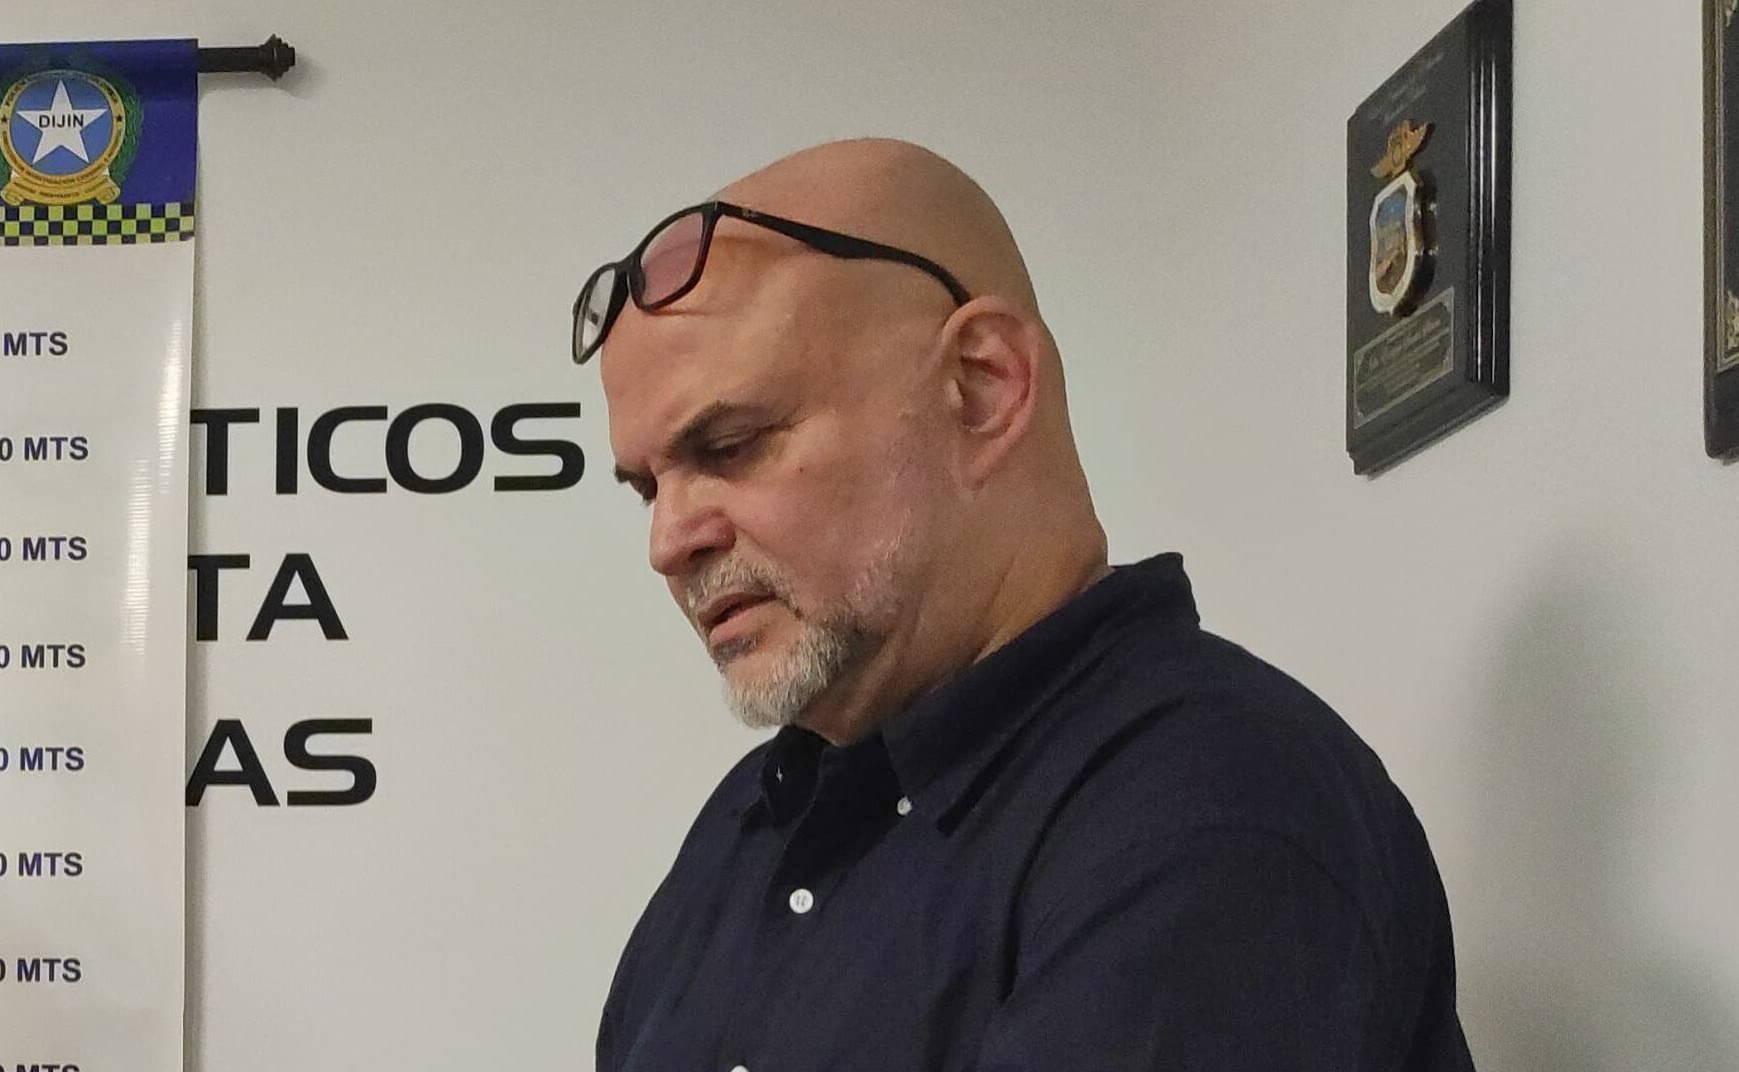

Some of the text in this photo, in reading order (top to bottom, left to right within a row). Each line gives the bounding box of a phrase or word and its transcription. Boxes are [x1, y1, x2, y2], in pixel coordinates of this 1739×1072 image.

[38, 114, 84, 128] DIJIN
[3, 331, 68, 357] MTS
[24, 436, 89, 462] MTS
[22, 536, 88, 562] MTS
[21, 643, 86, 669] MTS
[19, 746, 85, 772] MTS
[18, 852, 83, 877] MTS
[16, 957, 82, 983] MTS
